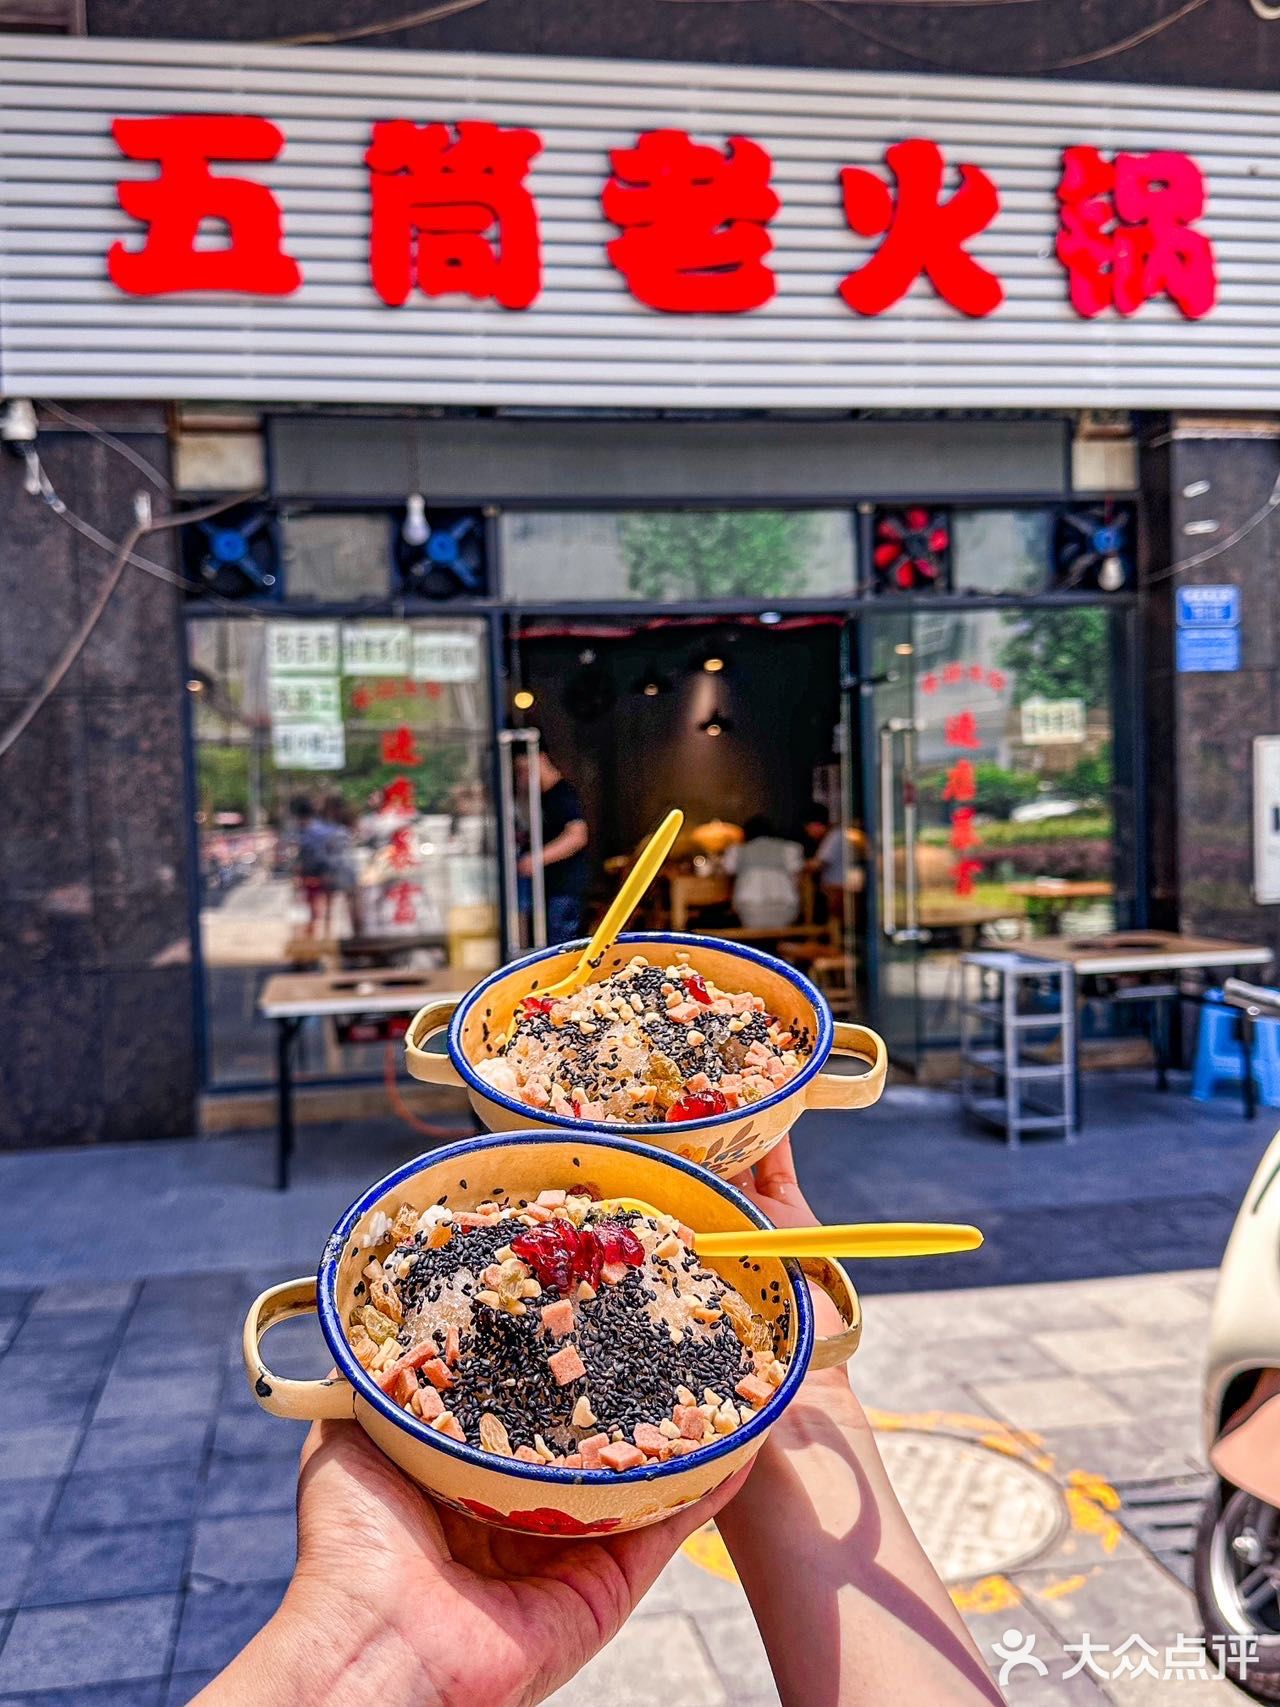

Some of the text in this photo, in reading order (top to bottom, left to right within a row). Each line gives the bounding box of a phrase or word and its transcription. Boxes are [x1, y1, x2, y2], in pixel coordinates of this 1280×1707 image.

[107, 115, 1218, 319] 五筒老火锅
